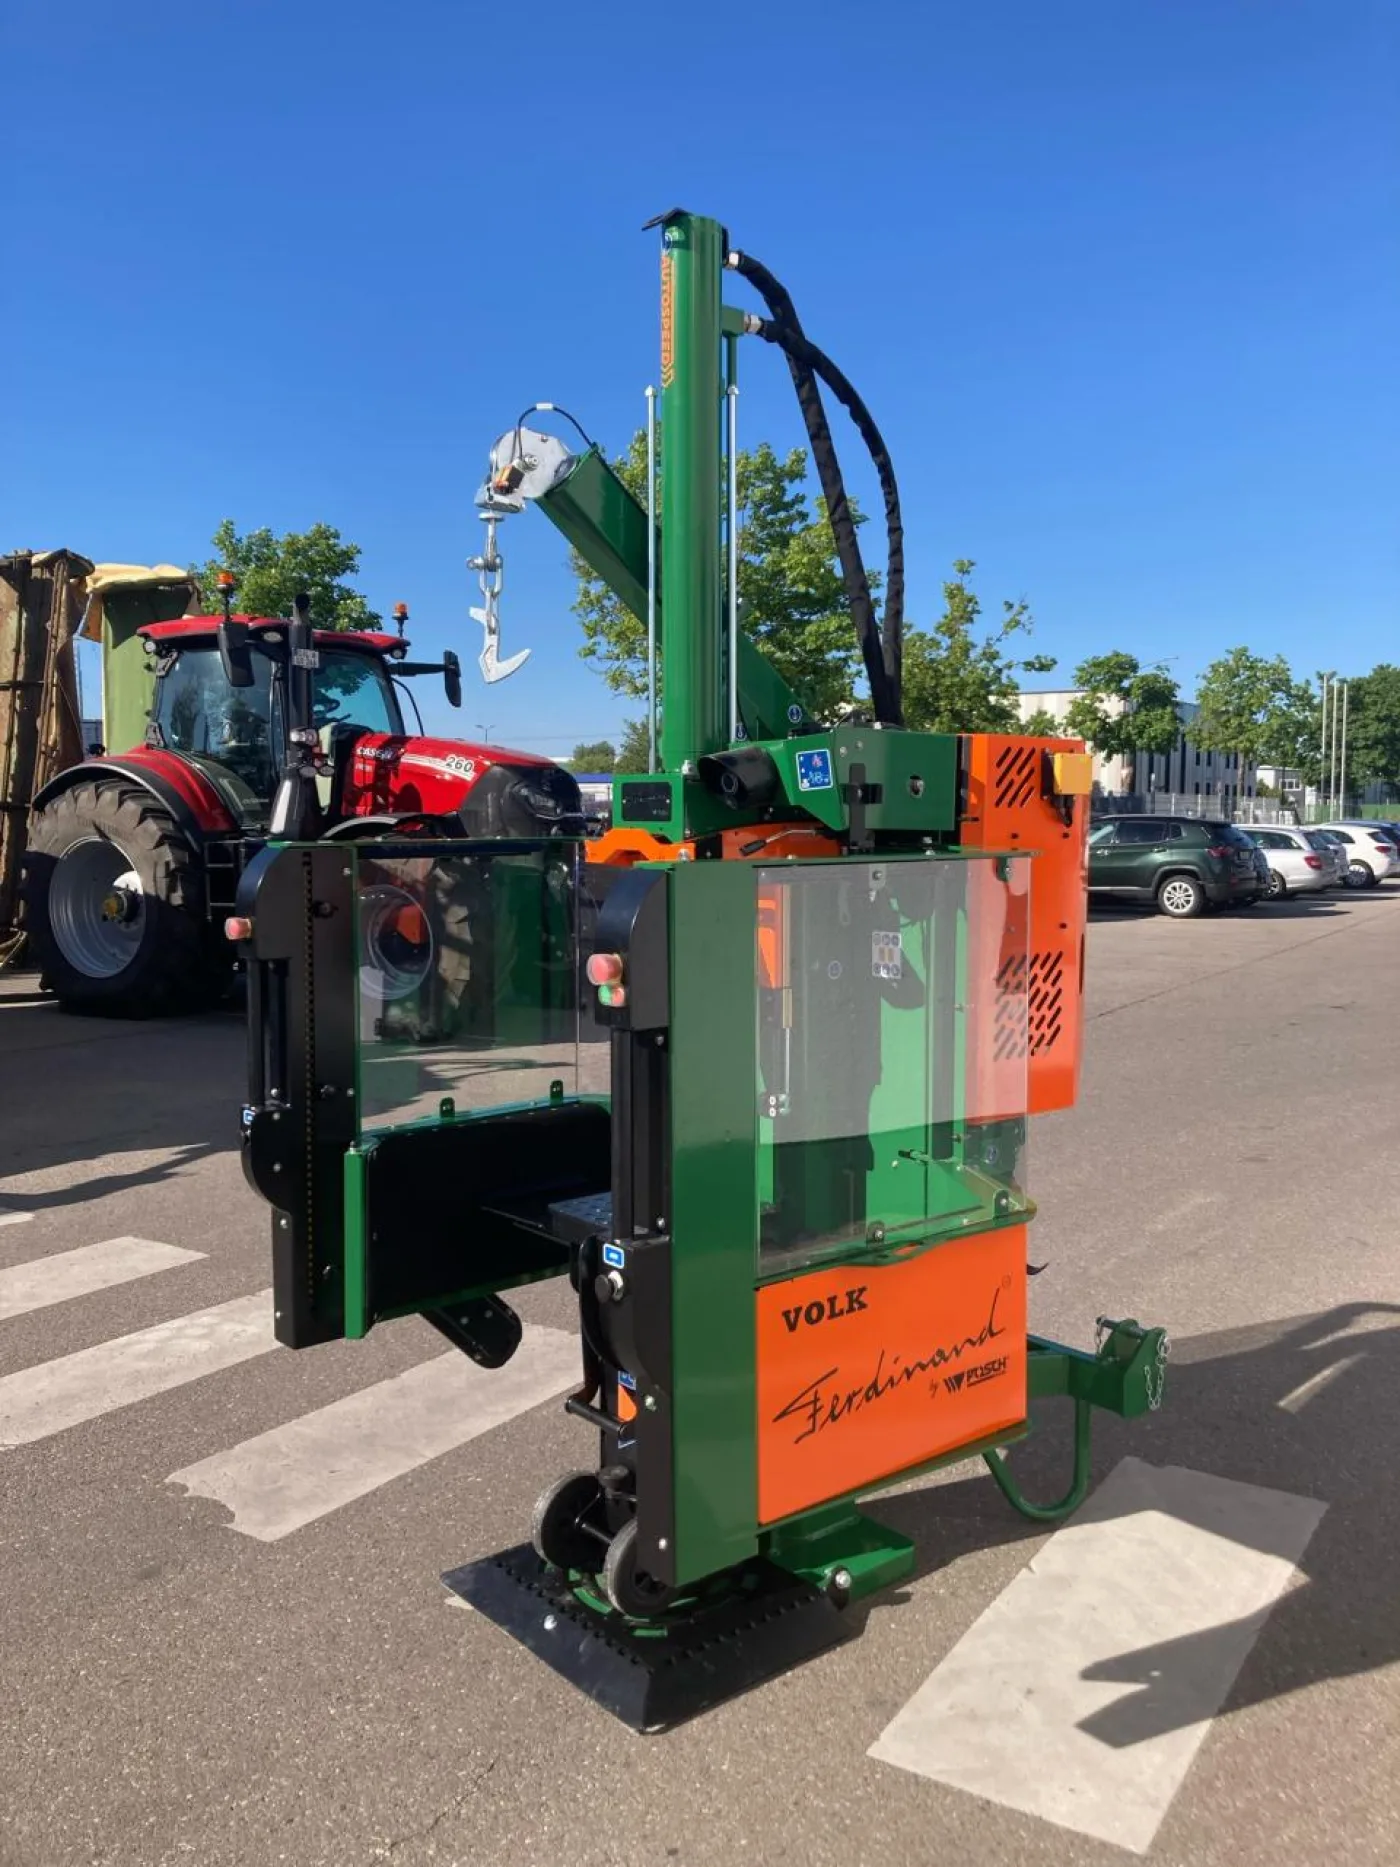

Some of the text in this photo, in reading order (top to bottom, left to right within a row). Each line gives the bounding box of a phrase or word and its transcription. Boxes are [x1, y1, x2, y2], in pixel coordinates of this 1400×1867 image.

[446, 756, 473, 773] 260
[782, 1286, 869, 1333] VOLK
[772, 1287, 1007, 1445] Ferdinand
